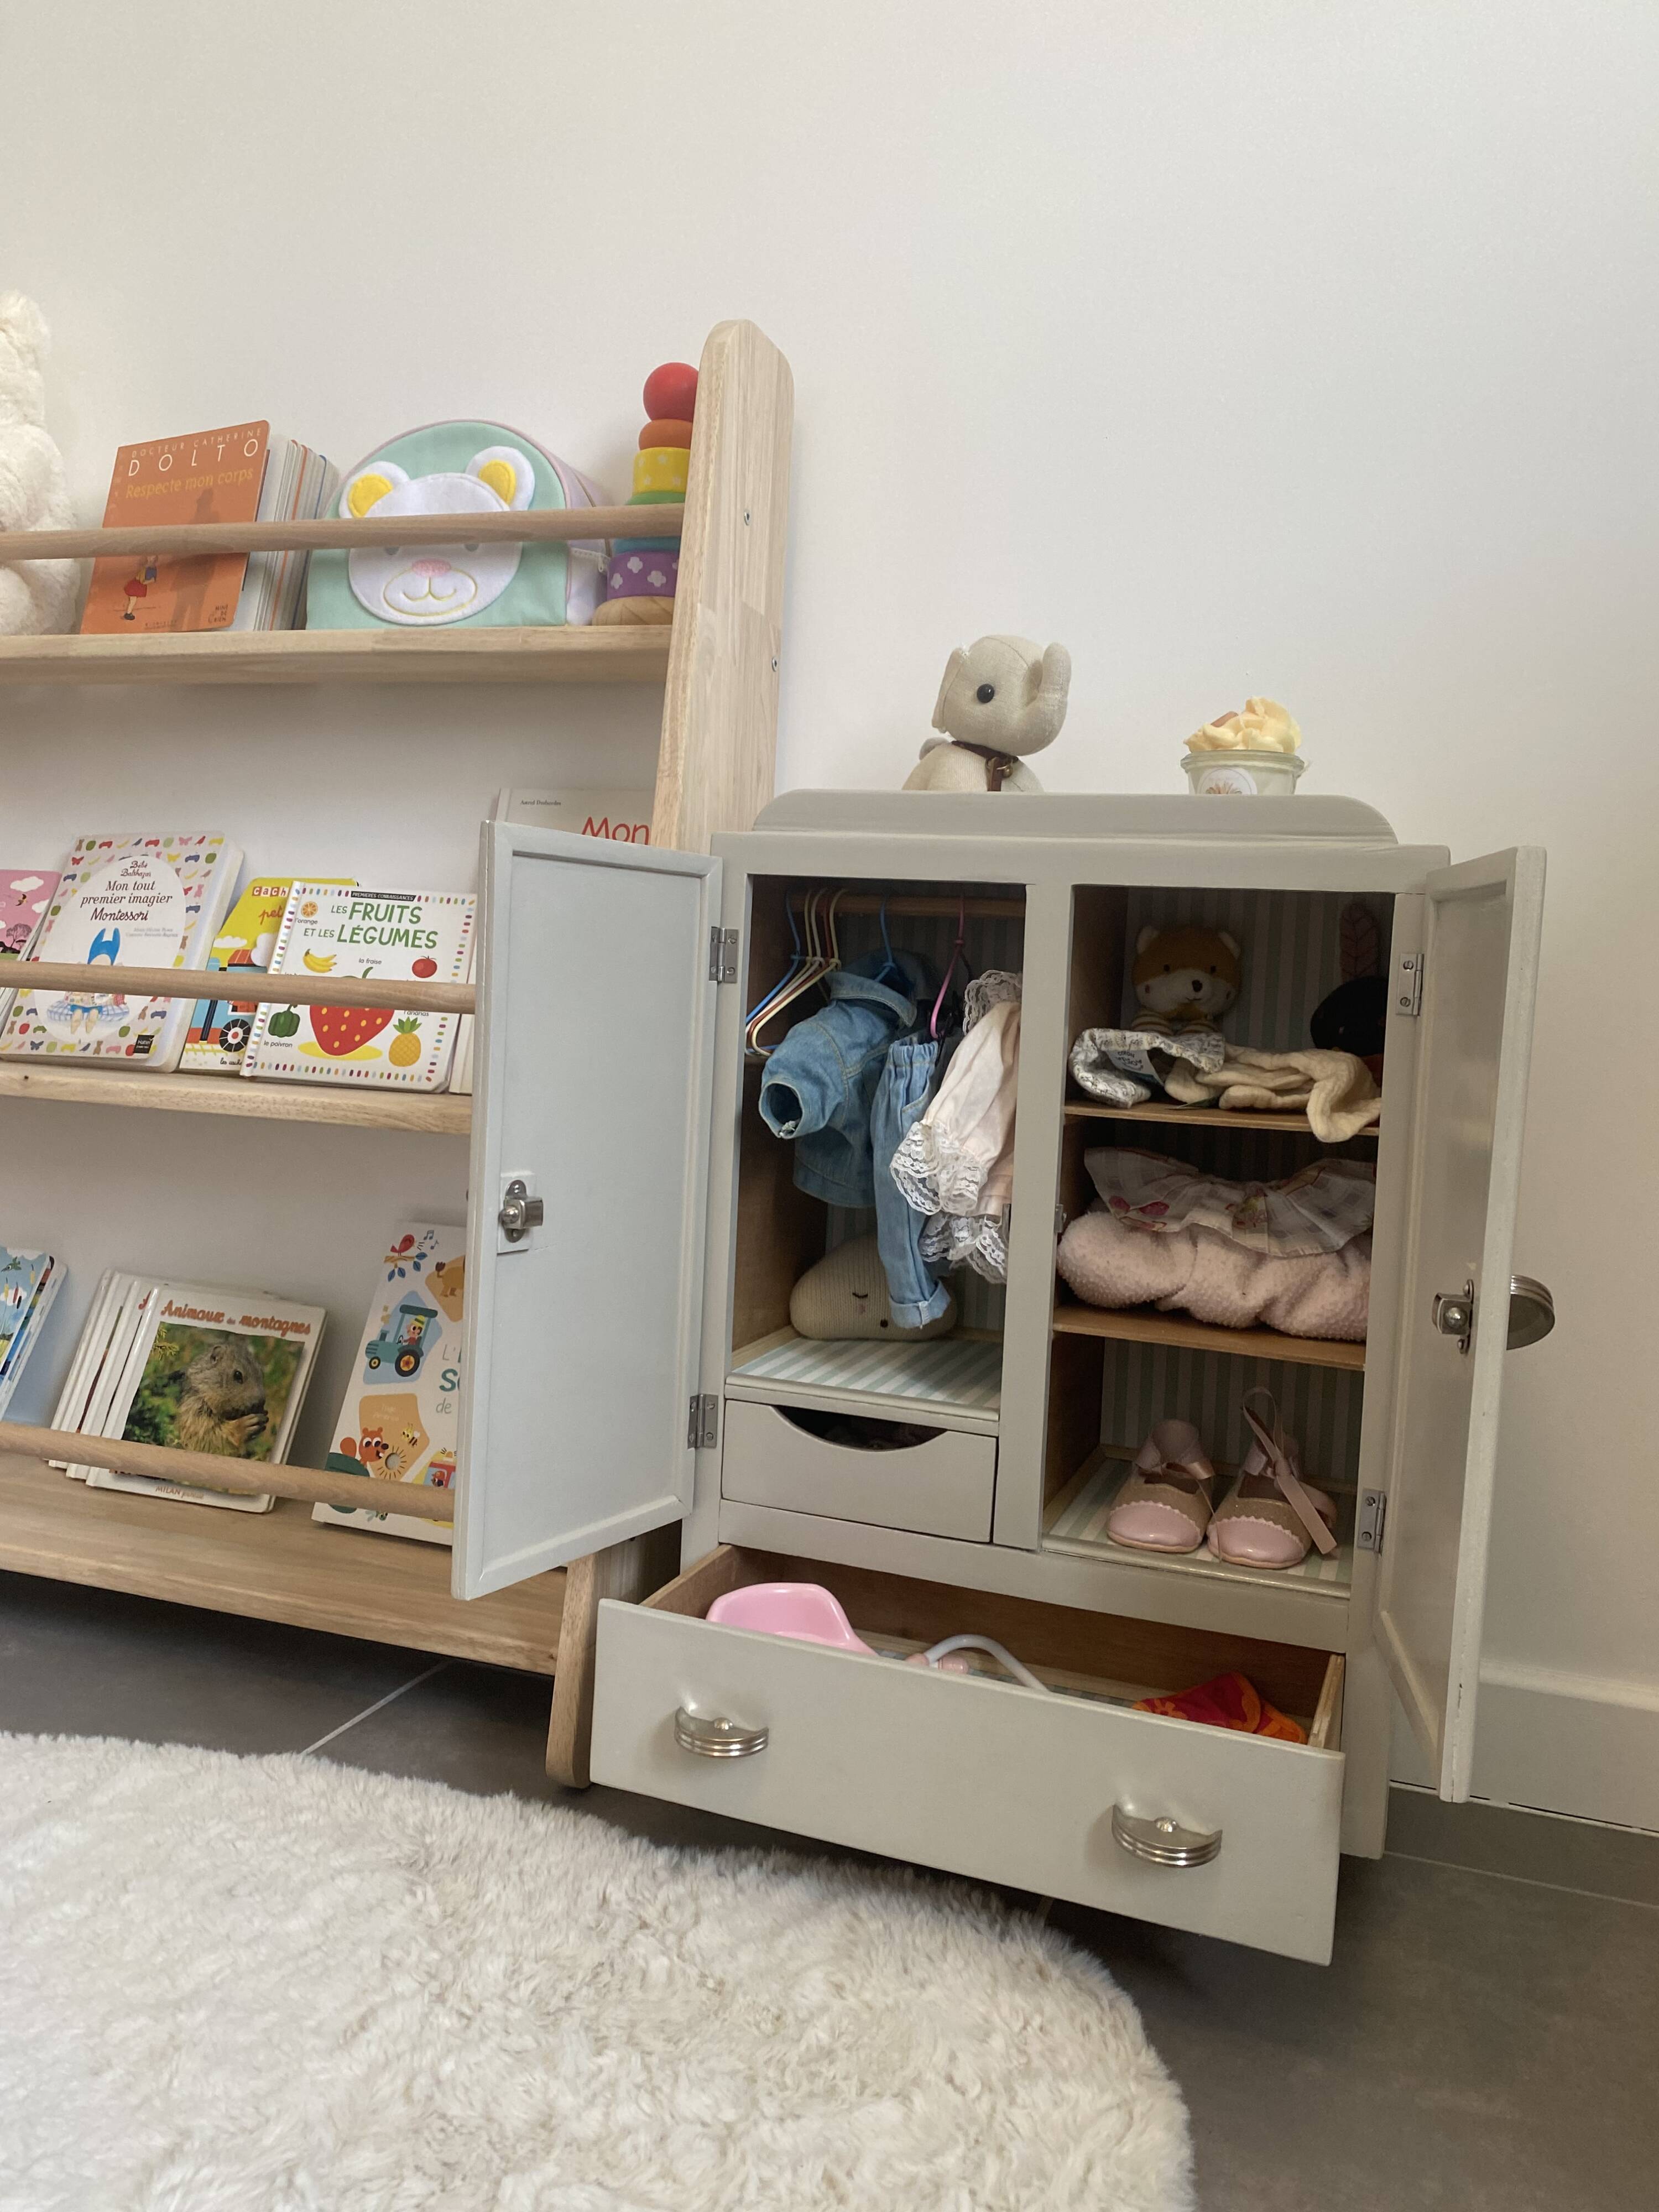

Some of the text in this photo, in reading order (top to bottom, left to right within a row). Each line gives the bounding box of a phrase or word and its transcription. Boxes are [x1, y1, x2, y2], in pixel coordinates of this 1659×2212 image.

[132, 428, 262, 458] DOCTEUR CATHERINE
[128, 439, 258, 476] DOLTO
[126, 468, 254, 499] Respecte mon corps
[581, 816, 650, 846] Mon
[120, 868, 151, 879] Balthazar
[105, 880, 155, 891] Mon tout
[80, 893, 173, 908] premier imagier
[90, 907, 149, 921] Montessori
[331, 902, 422, 924] LES FRUITS
[304, 924, 438, 949] ET LES LÉGUMES
[160, 1300, 225, 1323] Animaux
[239, 1314, 311, 1337] montagnes
[436, 1398, 452, 1414] de
[155, 1485, 181, 1495] MILAN
